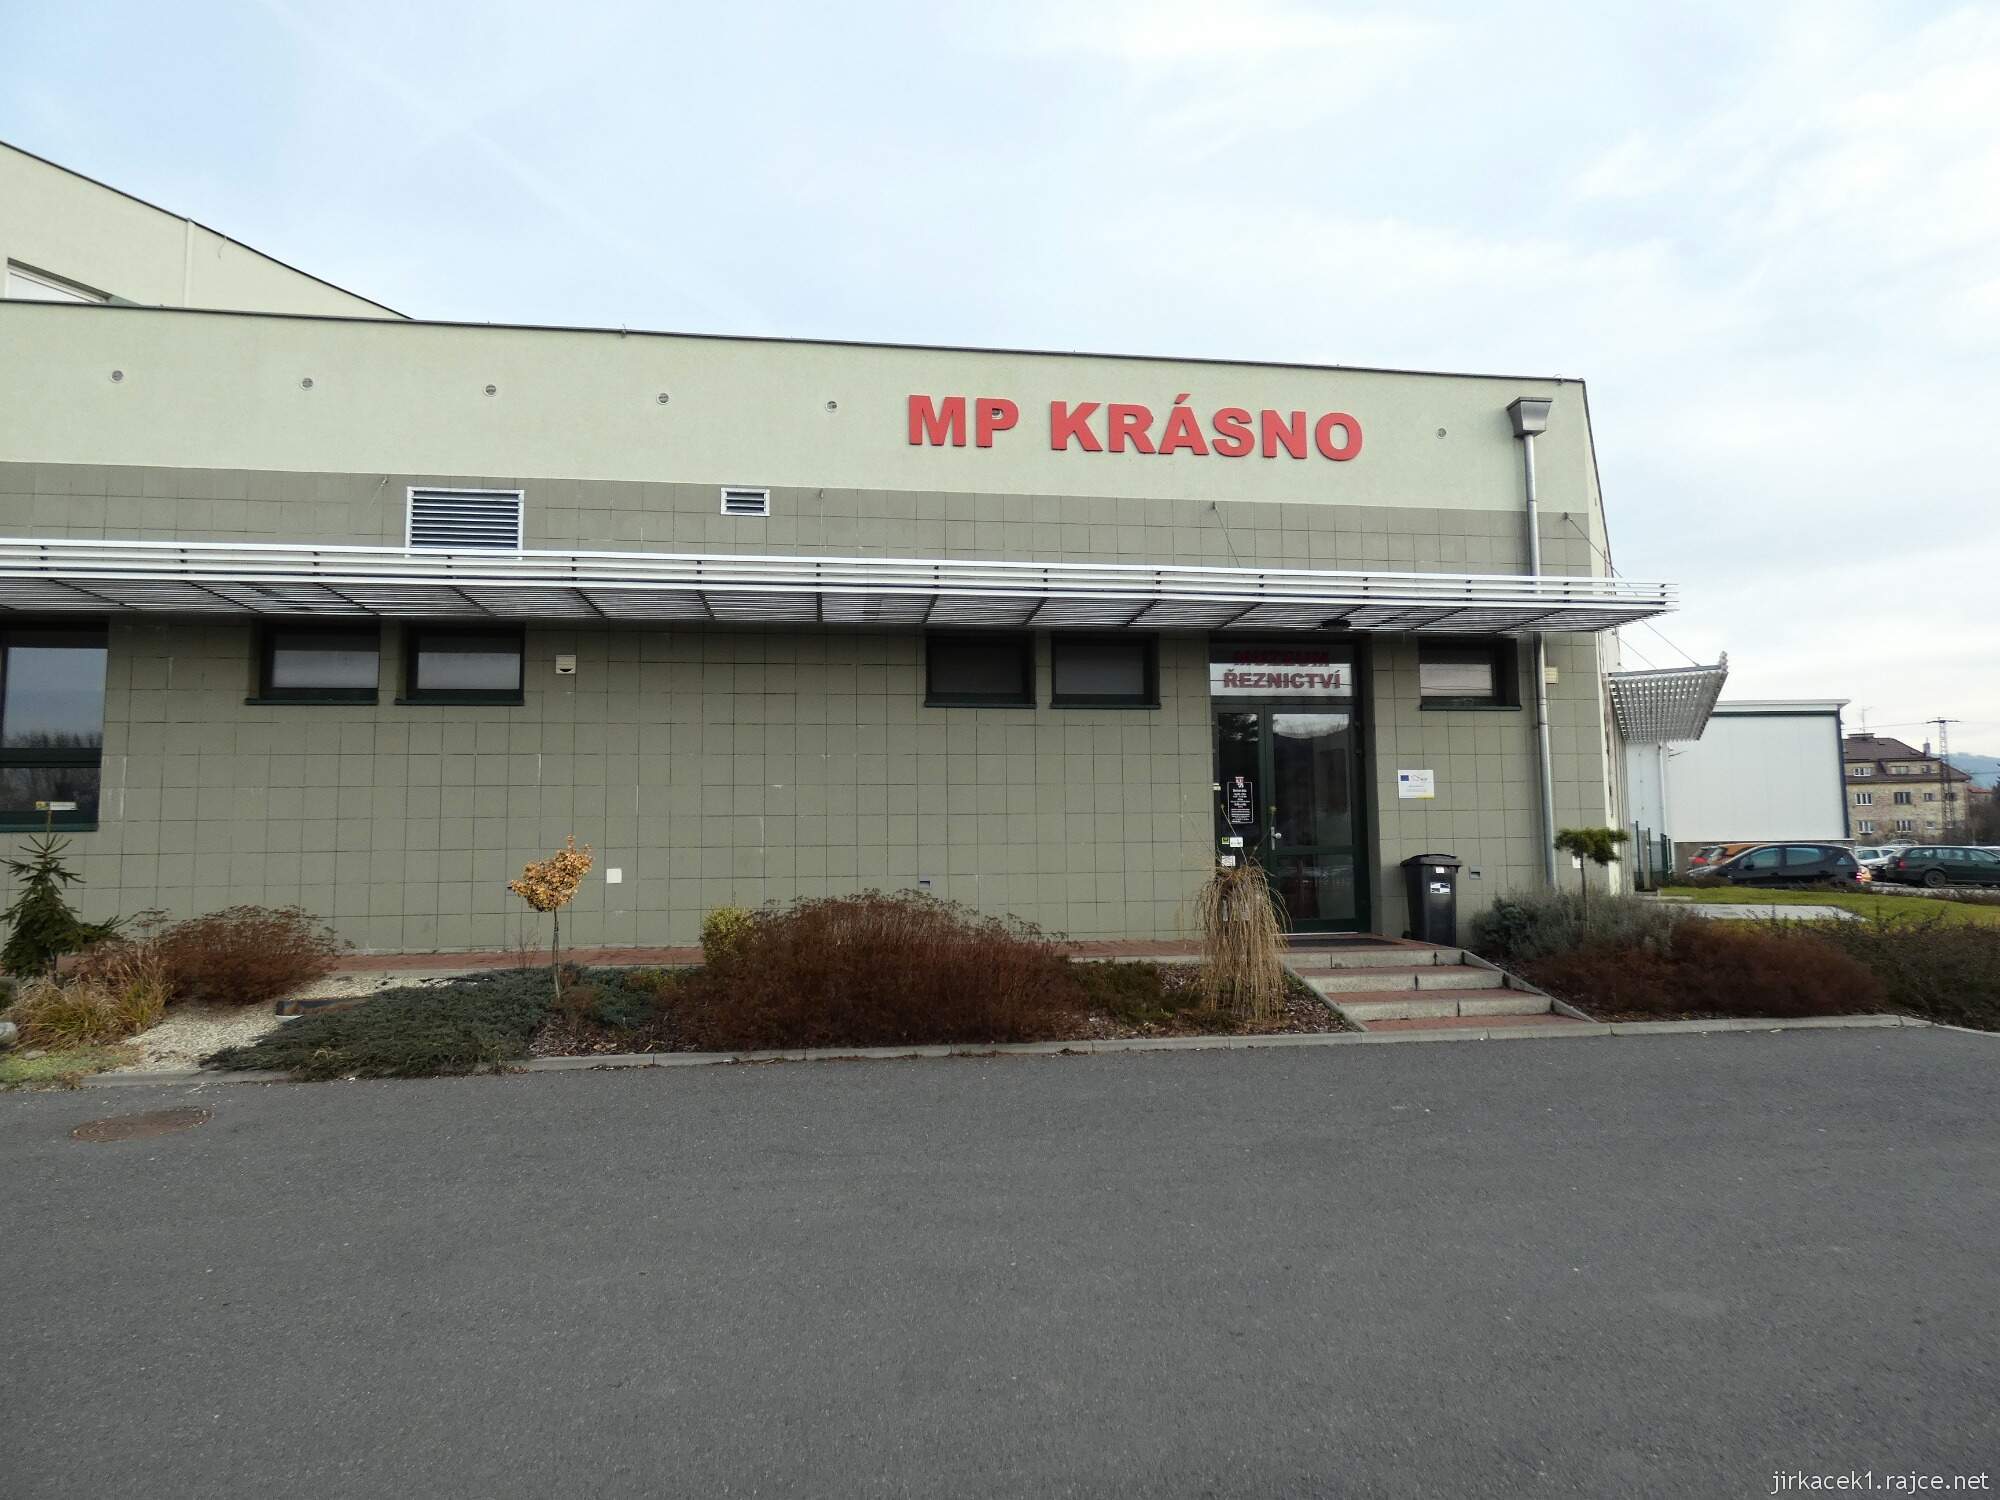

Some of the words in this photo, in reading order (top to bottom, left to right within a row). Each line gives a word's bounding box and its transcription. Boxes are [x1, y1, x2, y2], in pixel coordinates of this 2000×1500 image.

[907, 394, 1020, 449] MP
[1050, 392, 1364, 462] KRÁSNO
[1223, 668, 1342, 689] ŘEZNICTVÍ
